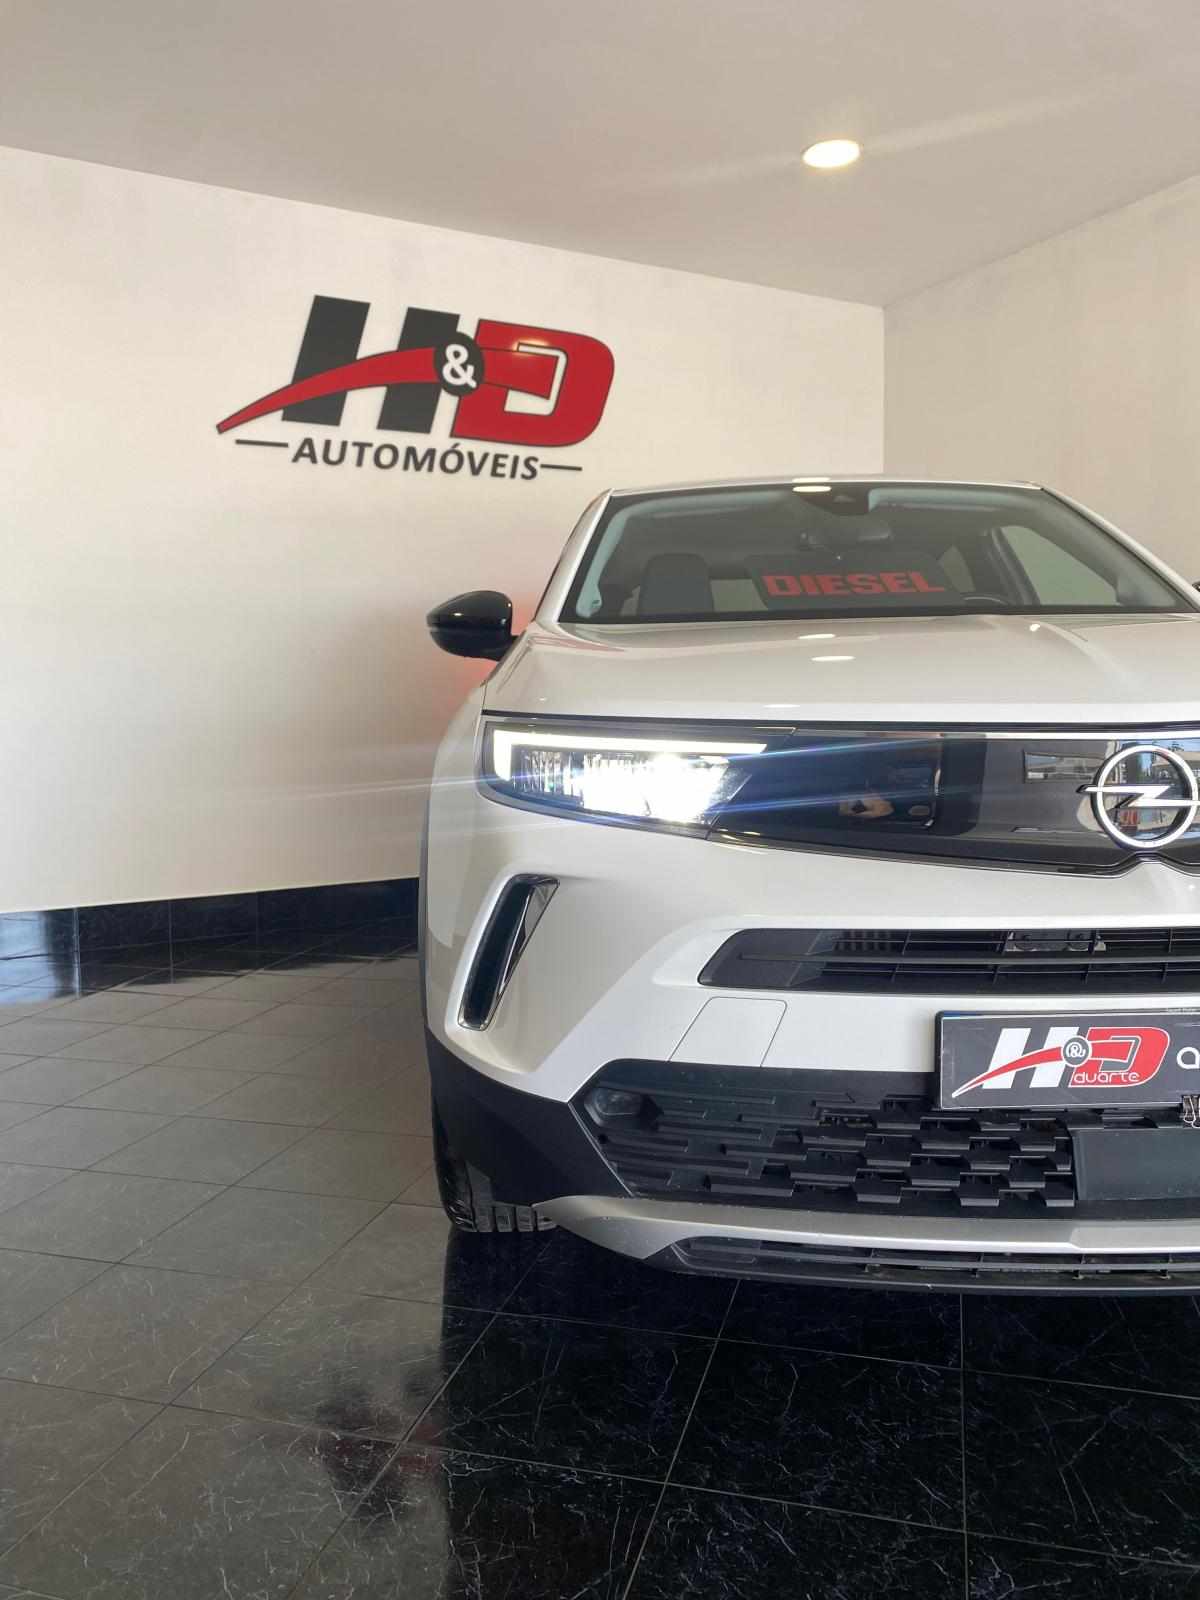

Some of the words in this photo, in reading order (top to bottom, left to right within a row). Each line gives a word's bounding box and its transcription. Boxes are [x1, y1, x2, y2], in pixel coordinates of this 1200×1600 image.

[216, 294, 616, 448] H&D
[292, 437, 540, 481] AUTOMÓVEIS
[762, 571, 945, 596] DIESEL
[953, 1026, 1170, 1098] H&D
[1073, 1071, 1141, 1084] duarte
